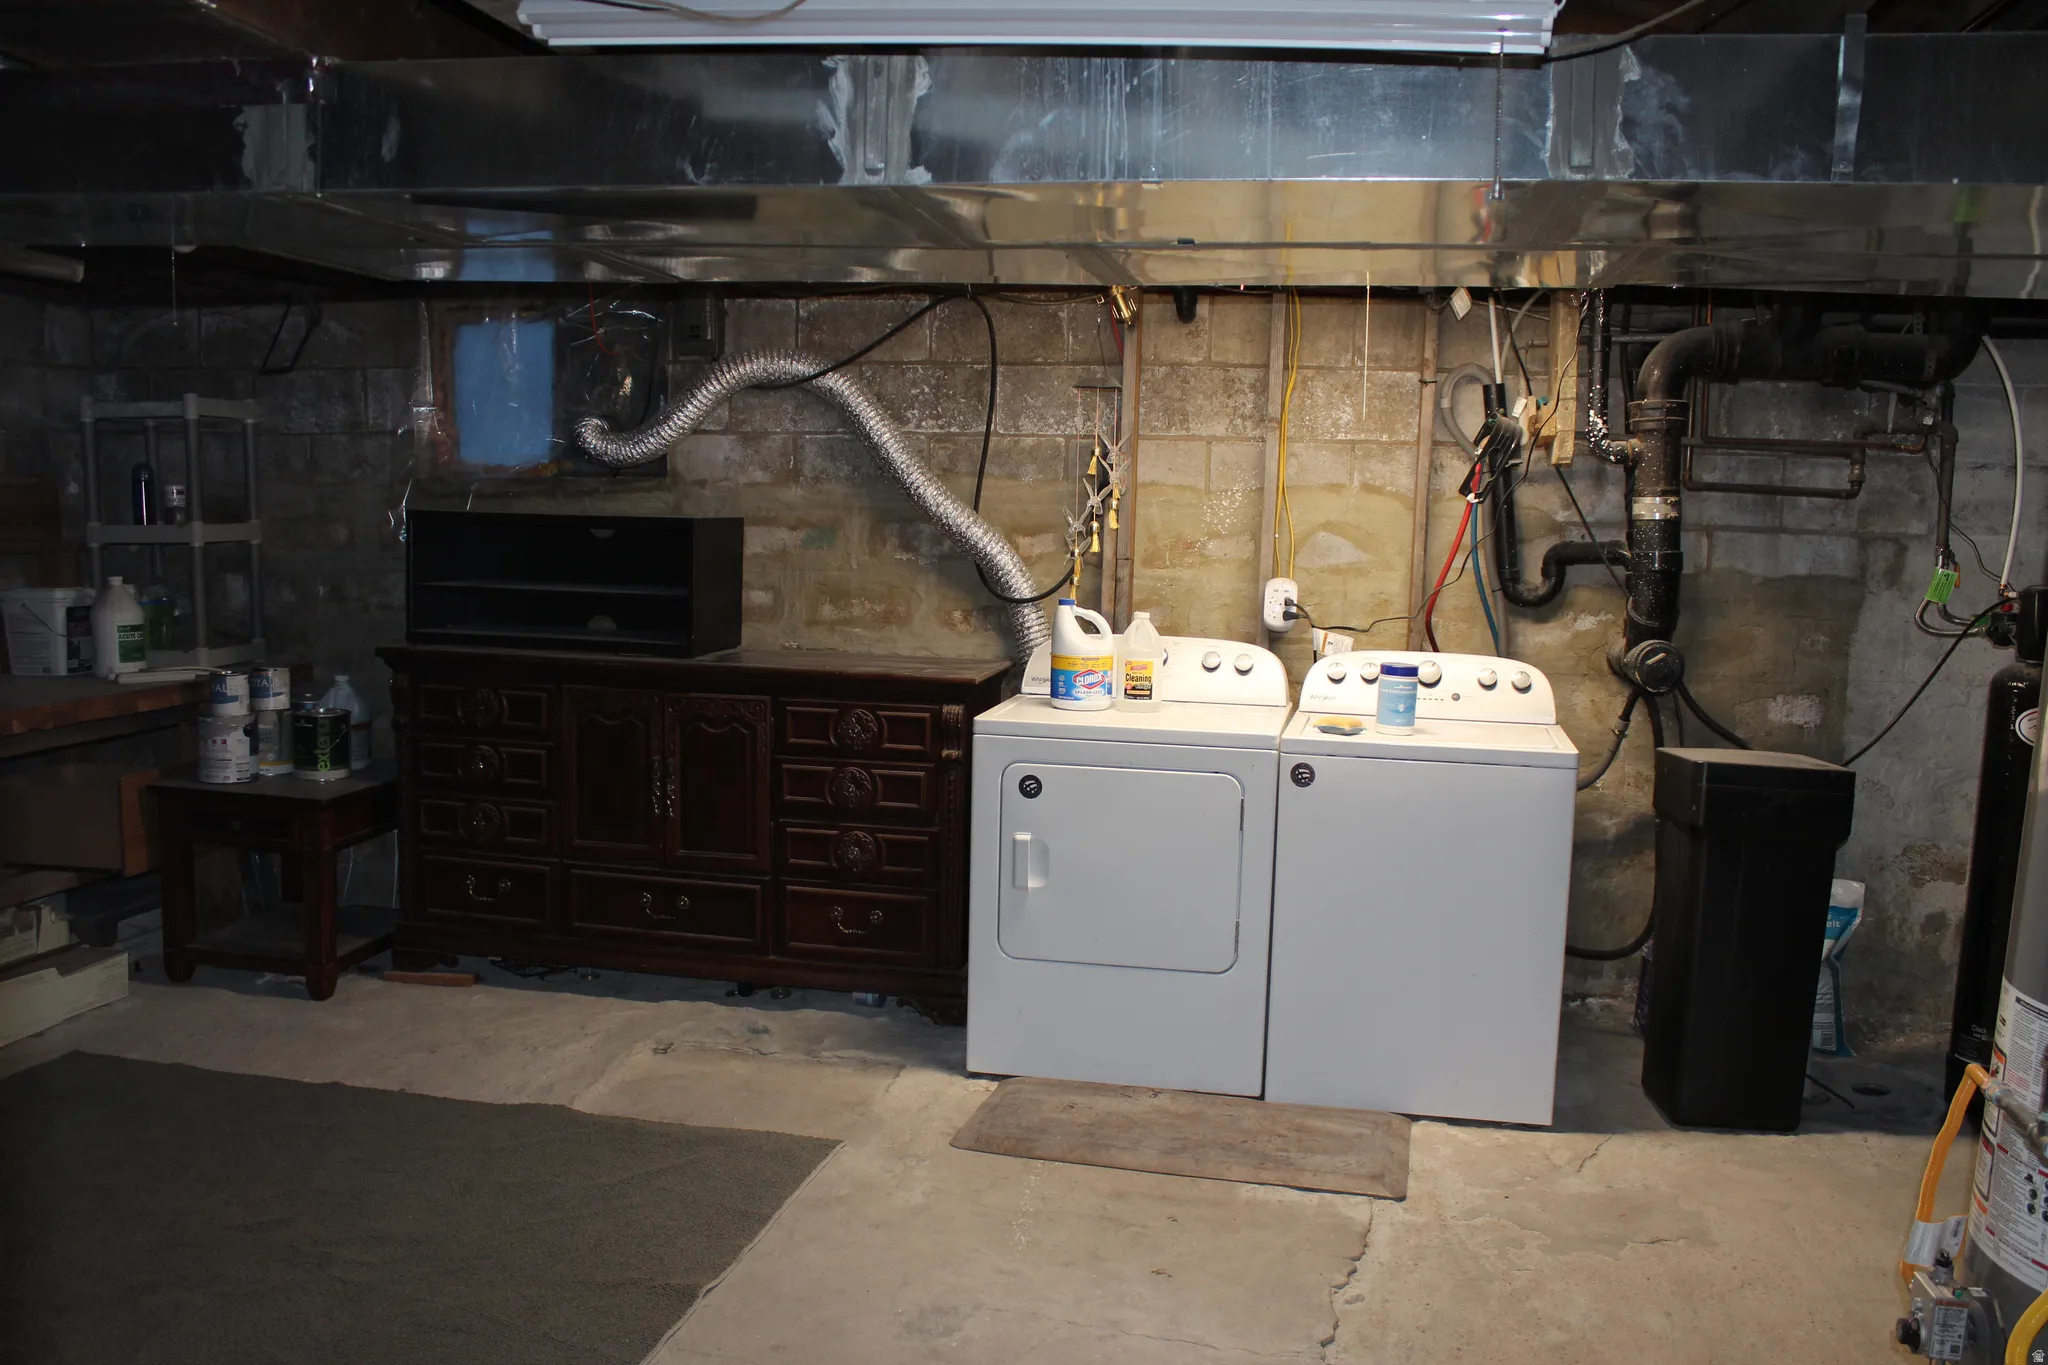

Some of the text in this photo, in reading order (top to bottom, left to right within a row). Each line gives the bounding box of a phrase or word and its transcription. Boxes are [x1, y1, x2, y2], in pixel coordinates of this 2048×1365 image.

[1076, 672, 1103, 686] CLOROX
[1125, 673, 1152, 684] Cleaning
[211, 683, 227, 693] YAL
